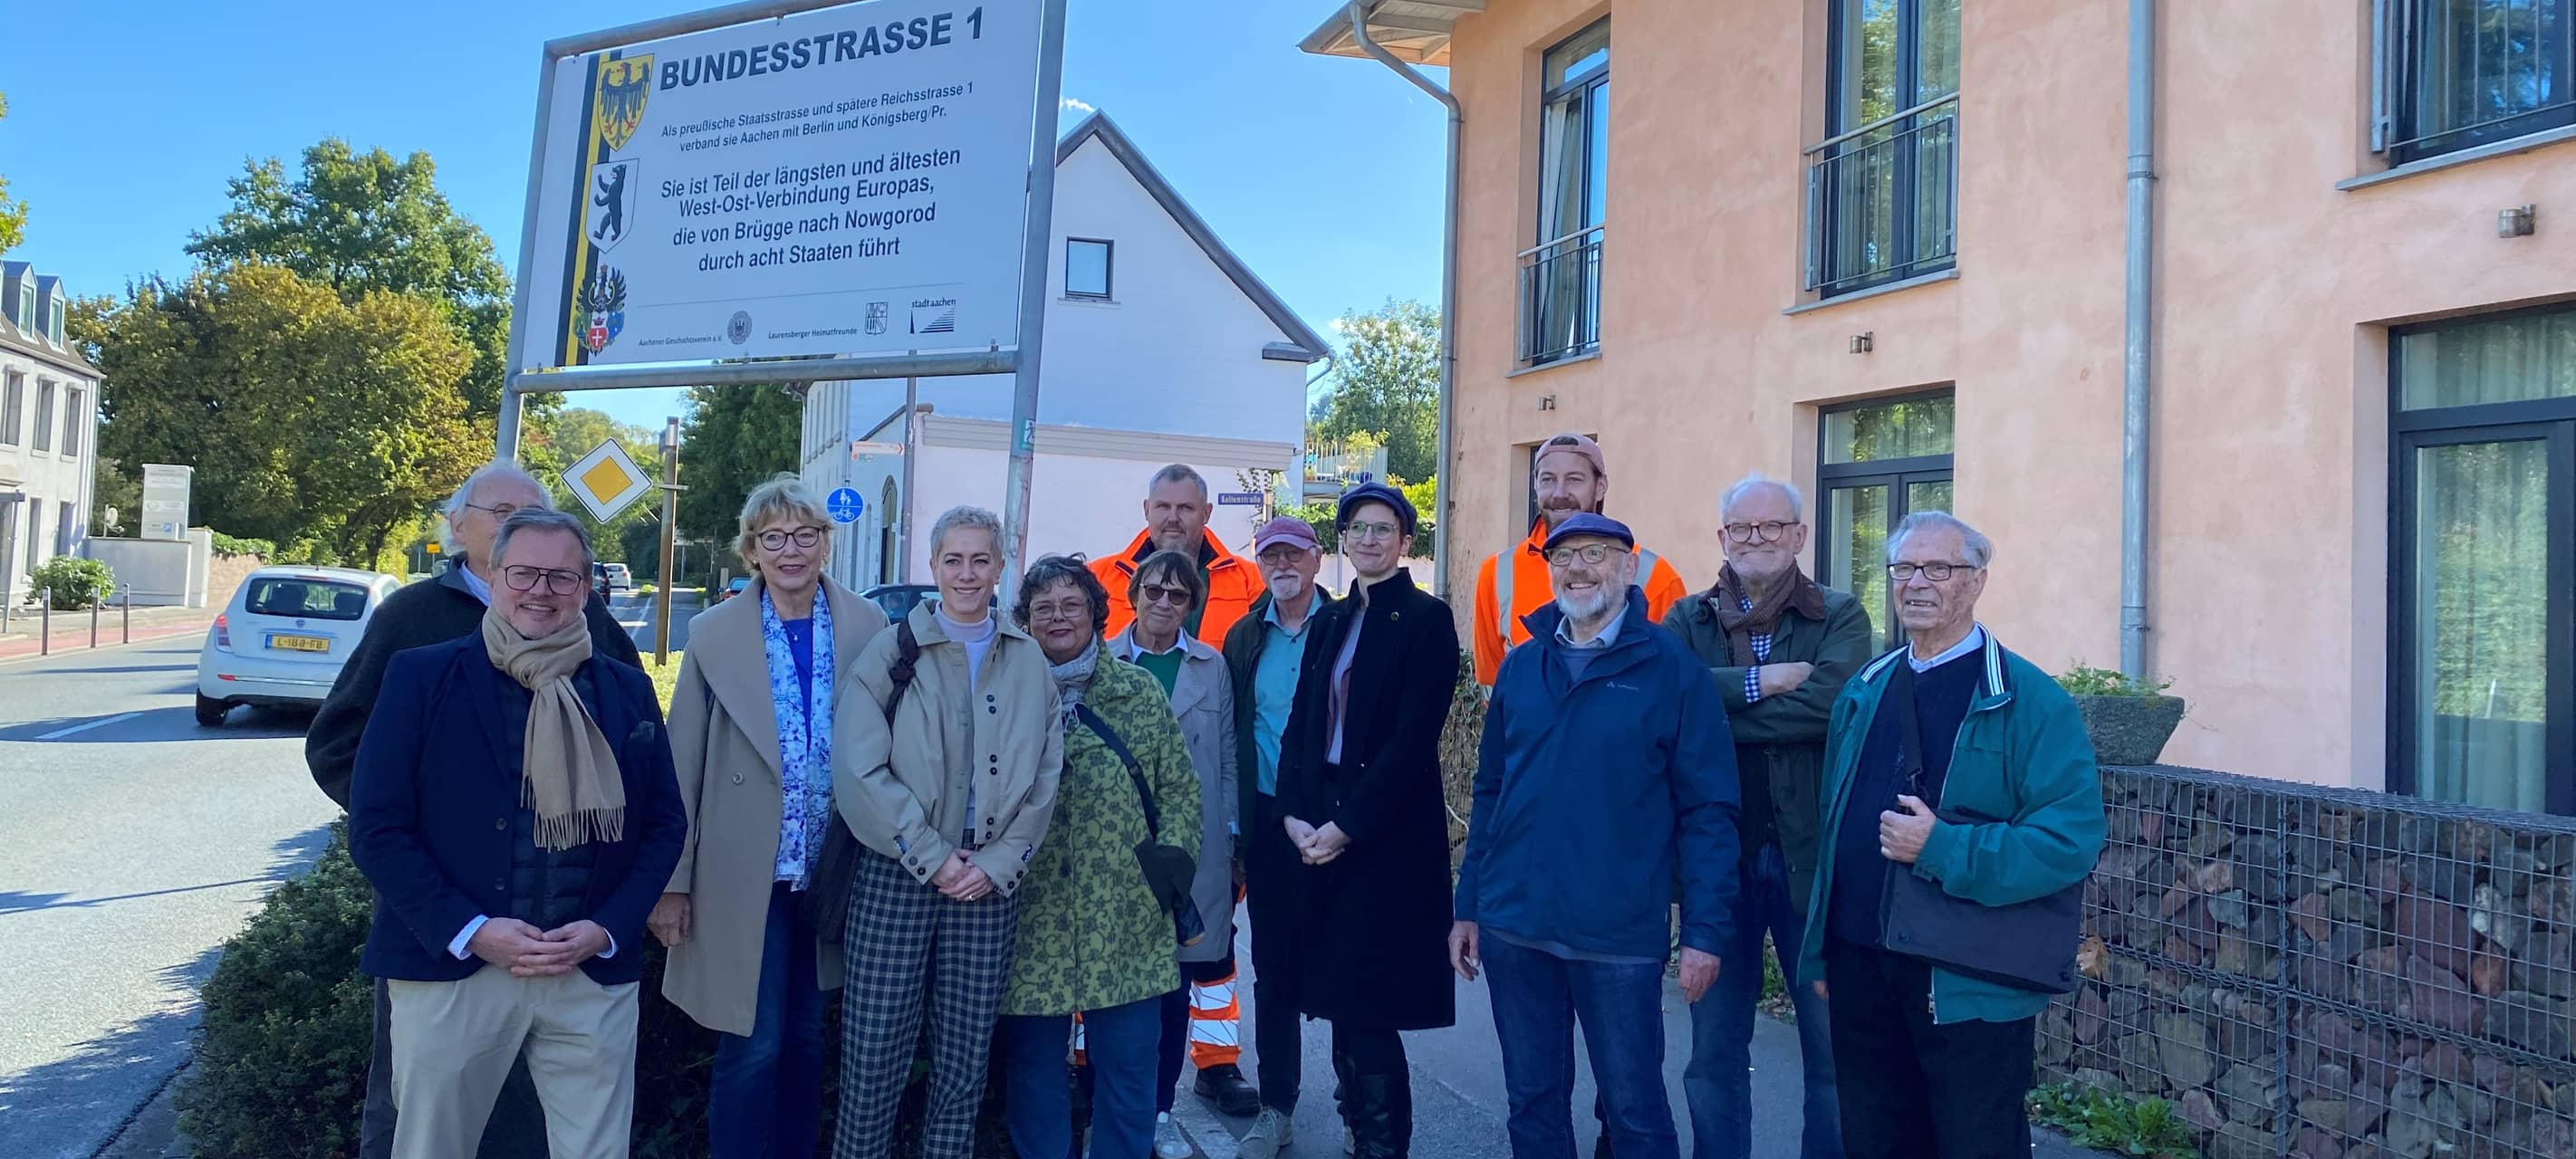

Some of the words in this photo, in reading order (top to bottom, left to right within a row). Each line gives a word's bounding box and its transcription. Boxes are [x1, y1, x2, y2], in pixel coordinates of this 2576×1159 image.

[659, 12, 953, 91] BUNDESSTRASSE
[966, 6, 983, 40] 1
[661, 125, 678, 138] Als
[679, 117, 735, 138] preußische
[738, 108, 810, 127] Staatsstrasse
[812, 101, 833, 116] und
[836, 95, 878, 115] spätere
[880, 85, 964, 106] Reichsstrasse
[967, 81, 974, 93] 1
[679, 136, 720, 152] verband
[723, 133, 738, 147] sie
[740, 128, 779, 144] Aachen
[782, 125, 800, 139] mit
[803, 120, 834, 135] Berlin
[837, 116, 859, 131] und
[861, 105, 947, 127] Königsberg/Pr.
[661, 179, 685, 198] Sie
[689, 177, 708, 195] ist
[713, 171, 740, 192] Teil
[744, 169, 770, 188] der
[774, 162, 846, 187] längsten
[852, 154, 885, 177] und
[889, 148, 961, 172] ältesten
[679, 184, 851, 217] West-Ost-Verbindung
[857, 176, 934, 199] Europas,
[673, 227, 697, 246] die
[701, 227, 729, 243] von
[735, 219, 793, 242] Brügge
[798, 212, 839, 234] nach
[845, 202, 936, 230] Nowgorod
[698, 250, 745, 272] durch
[749, 246, 784, 267] acht
[789, 244, 852, 264] Staaten
[859, 236, 900, 258] führt
[768, 329, 811, 340] Laurensberger
[812, 327, 858, 338] Heimatfreunde
